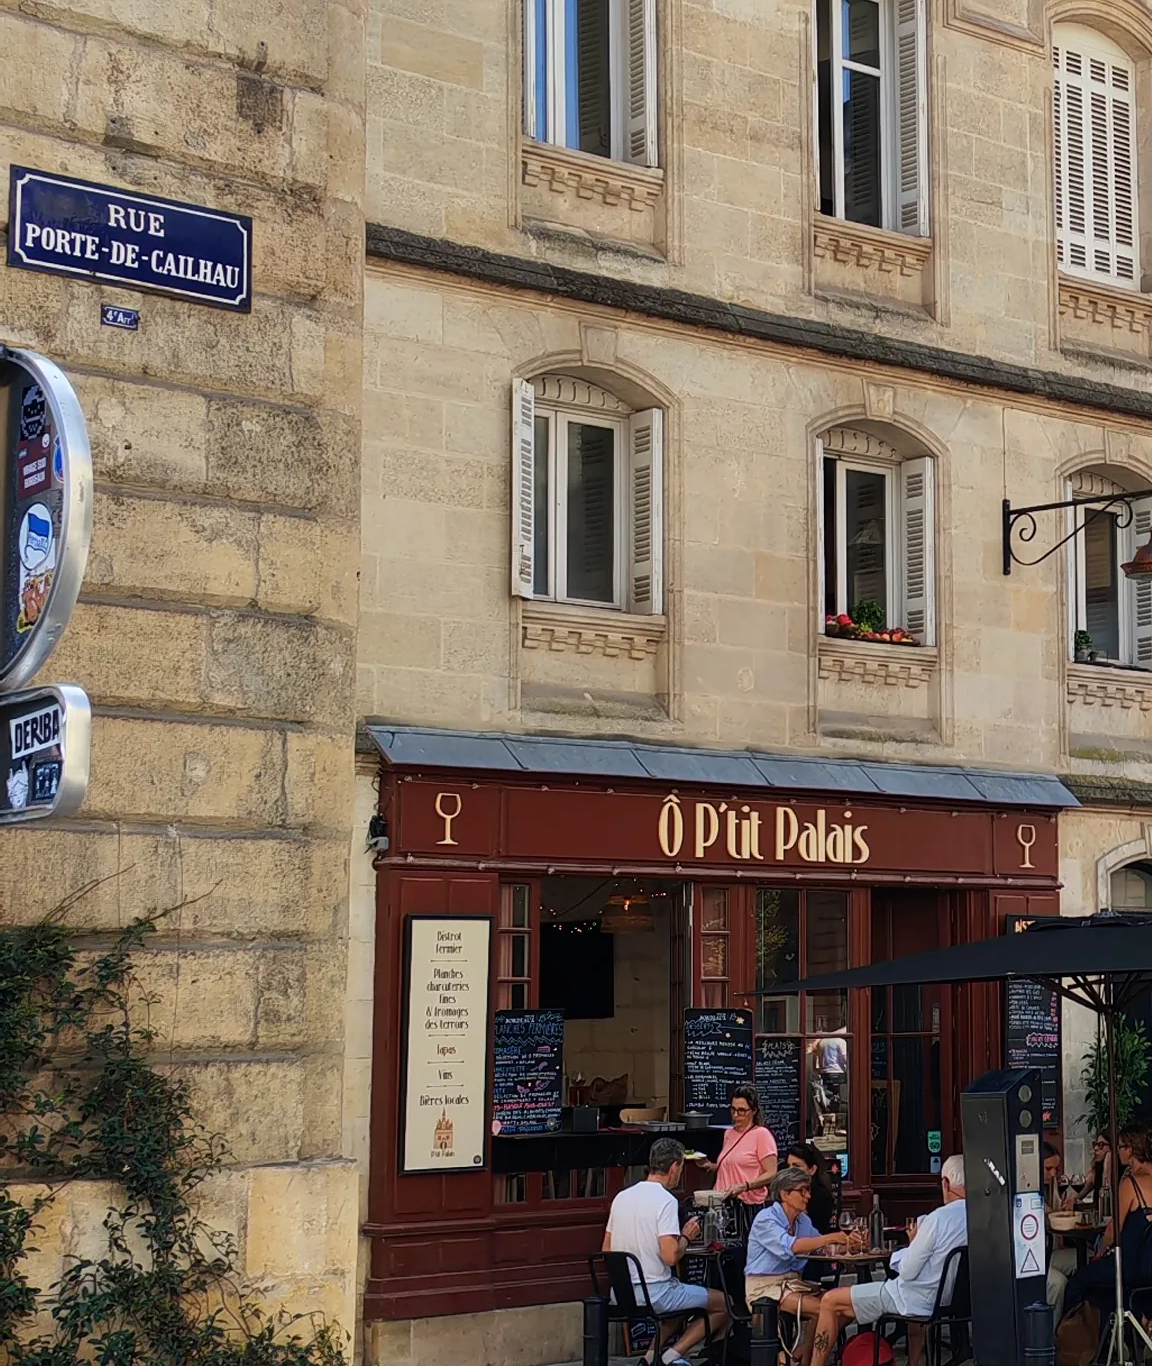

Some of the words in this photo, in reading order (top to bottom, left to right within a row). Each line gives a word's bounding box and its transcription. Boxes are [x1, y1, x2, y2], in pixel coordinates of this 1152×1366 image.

[108, 204, 165, 237] RUE
[25, 223, 240, 288] PORTE-DE-CAILHAU
[658, 794, 684, 857] Ô
[695, 801, 764, 860] P'tit
[775, 806, 870, 864] Palais
[437, 931, 462, 942] Bistrot
[433, 968, 464, 979] Planches
[425, 1019, 438, 1030] des
